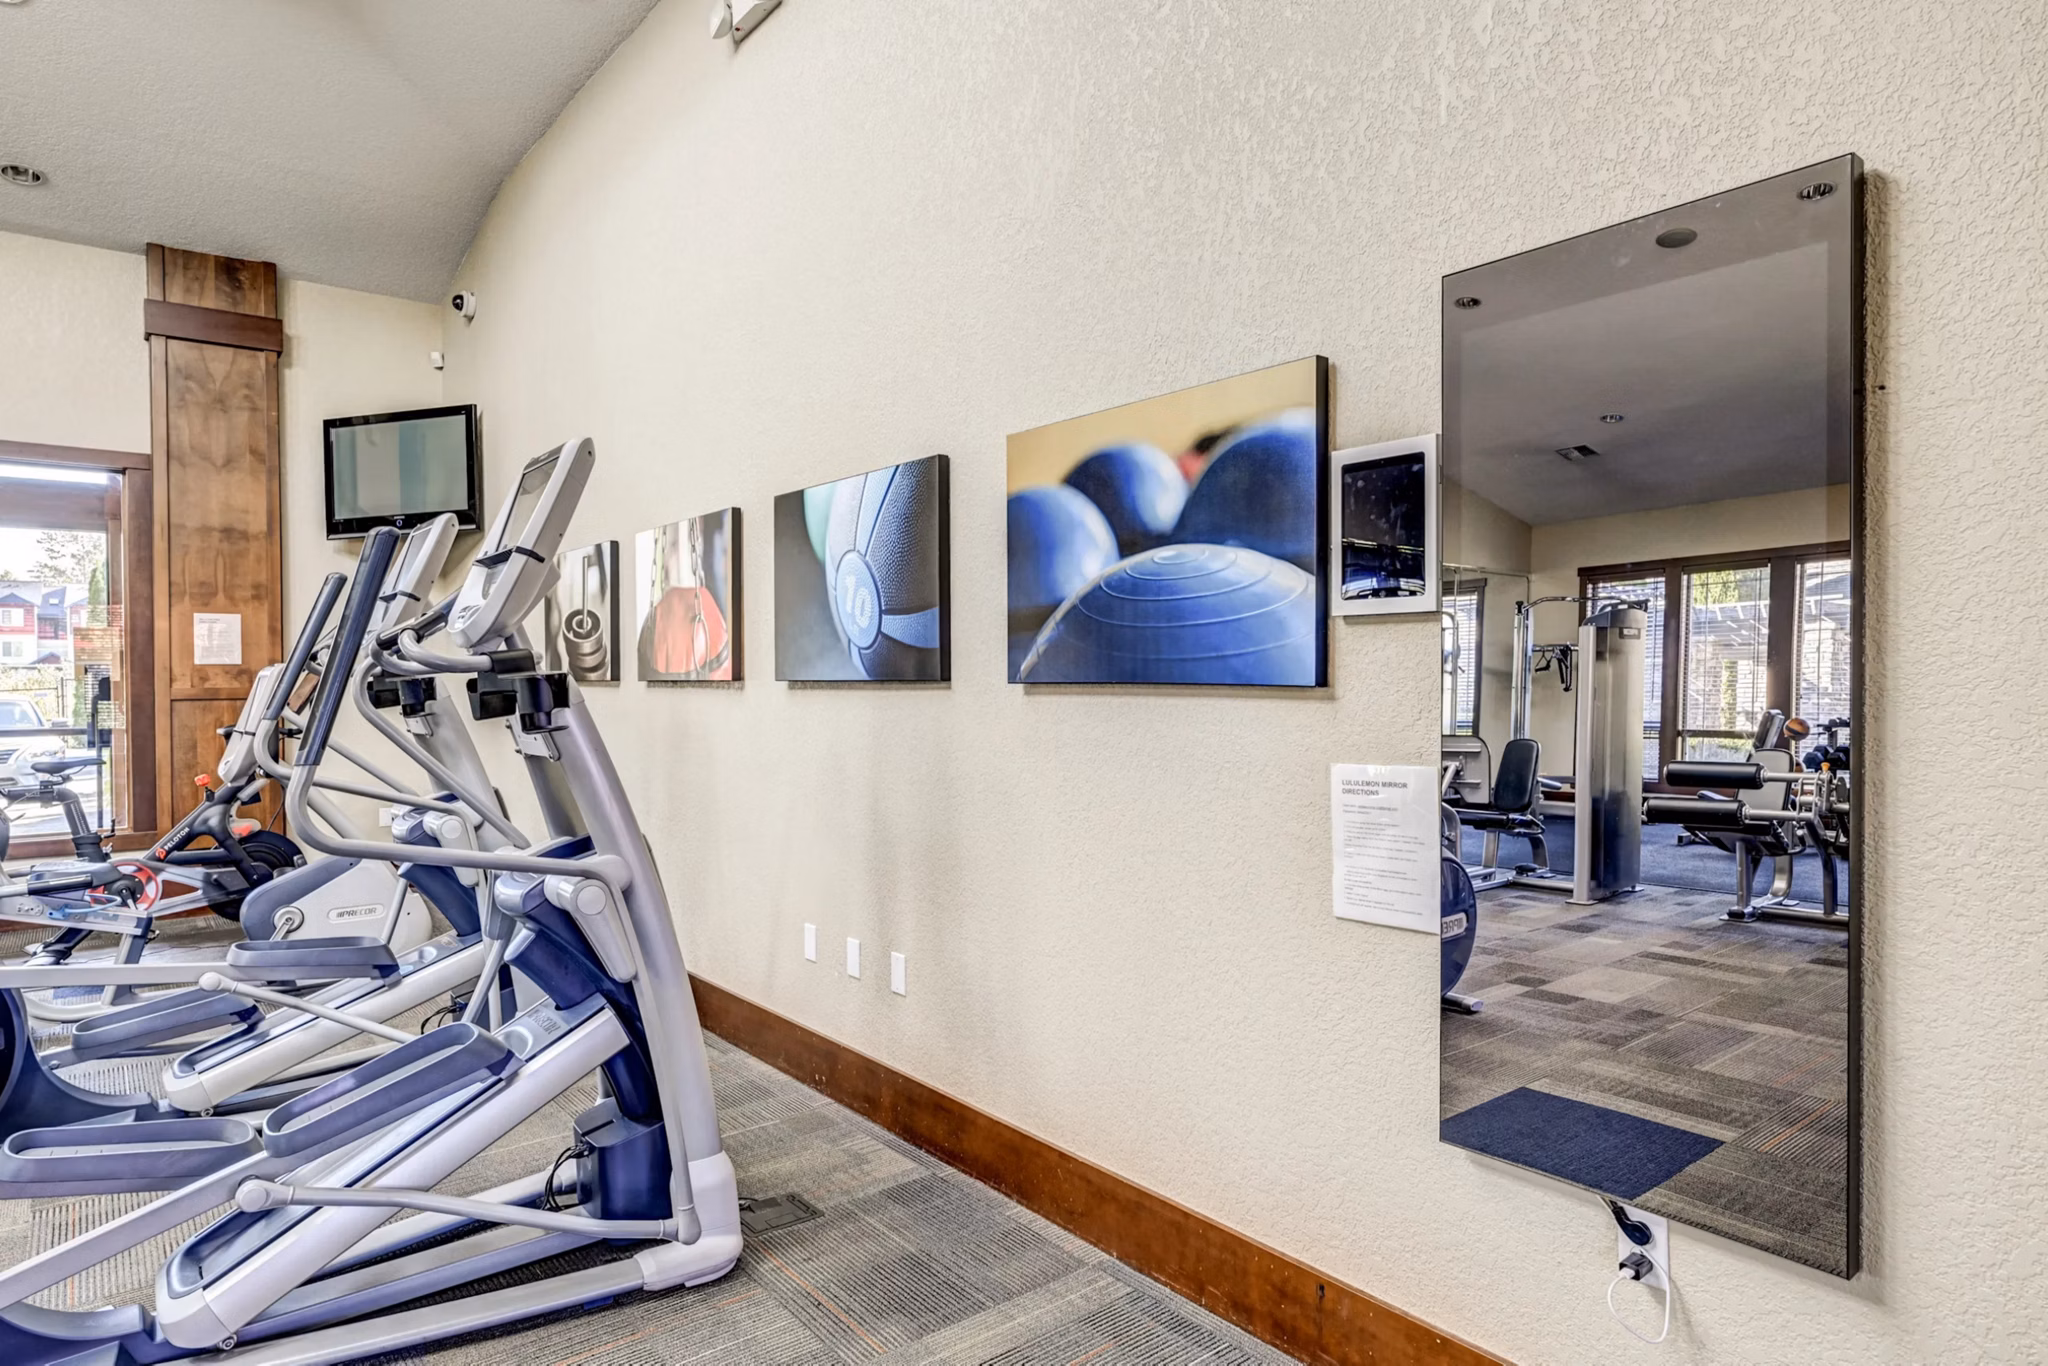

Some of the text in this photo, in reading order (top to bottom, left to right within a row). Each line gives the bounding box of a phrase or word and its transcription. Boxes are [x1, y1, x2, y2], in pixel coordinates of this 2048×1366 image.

[845, 574, 872, 629] 10
[1341, 779, 1408, 789] LULULEMON MIRROR
[1341, 787, 1380, 796] DIRECTIONS
[163, 826, 191, 851] PELOTON
[341, 907, 378, 918] PRECOR
